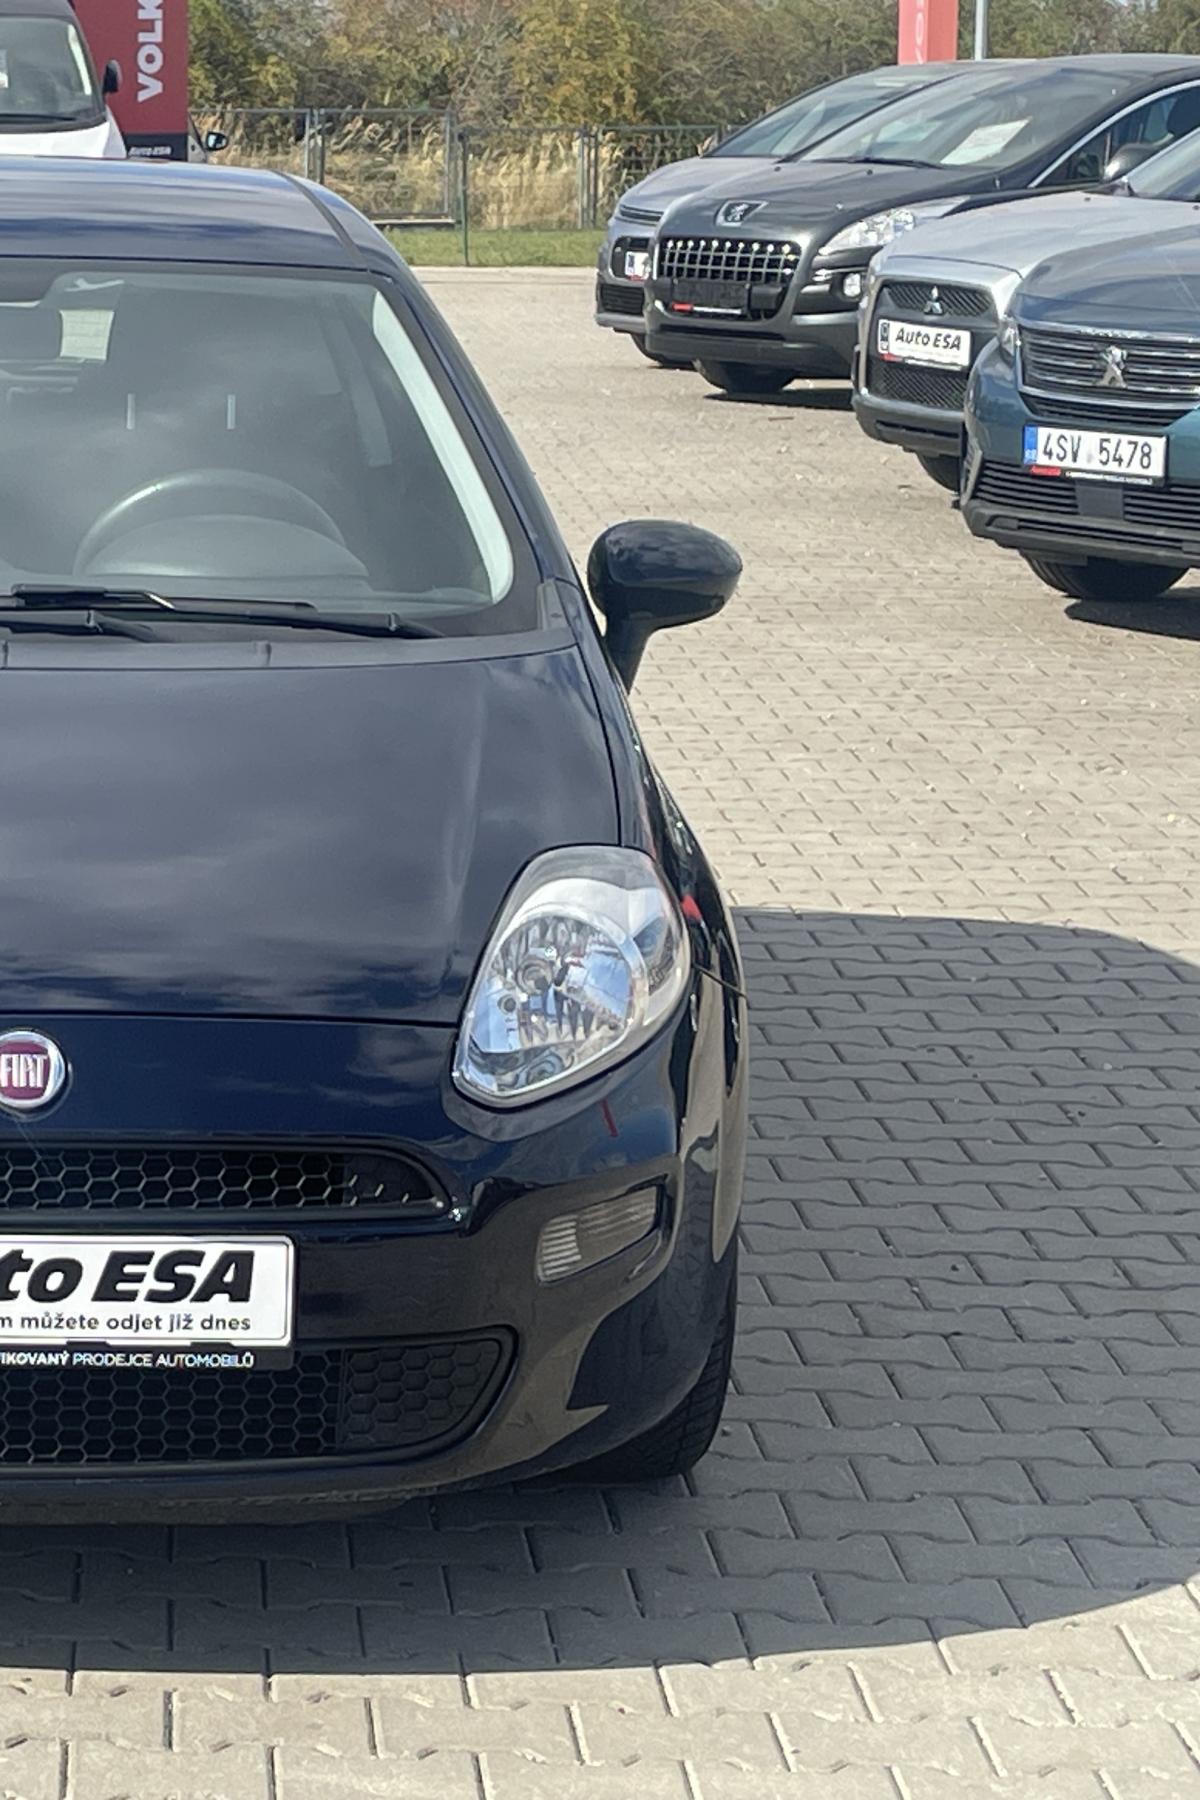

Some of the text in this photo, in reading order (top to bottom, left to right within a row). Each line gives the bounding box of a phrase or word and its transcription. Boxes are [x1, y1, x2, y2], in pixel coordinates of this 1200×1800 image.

[895, 327, 962, 351] Auto ESA
[1042, 433, 1082, 463] 4SV
[1099, 438, 1153, 469] 5478
[0, 1053, 48, 1088] FIAT
[91, 1250, 255, 1303] ESA
[21, 1312, 99, 1330] můžete
[106, 1313, 162, 1333] odjet
[200, 1314, 251, 1330] dnes
[73, 1352, 153, 1367] PRODEJCE
[156, 1351, 255, 1368] AUTOMOBILŮ
